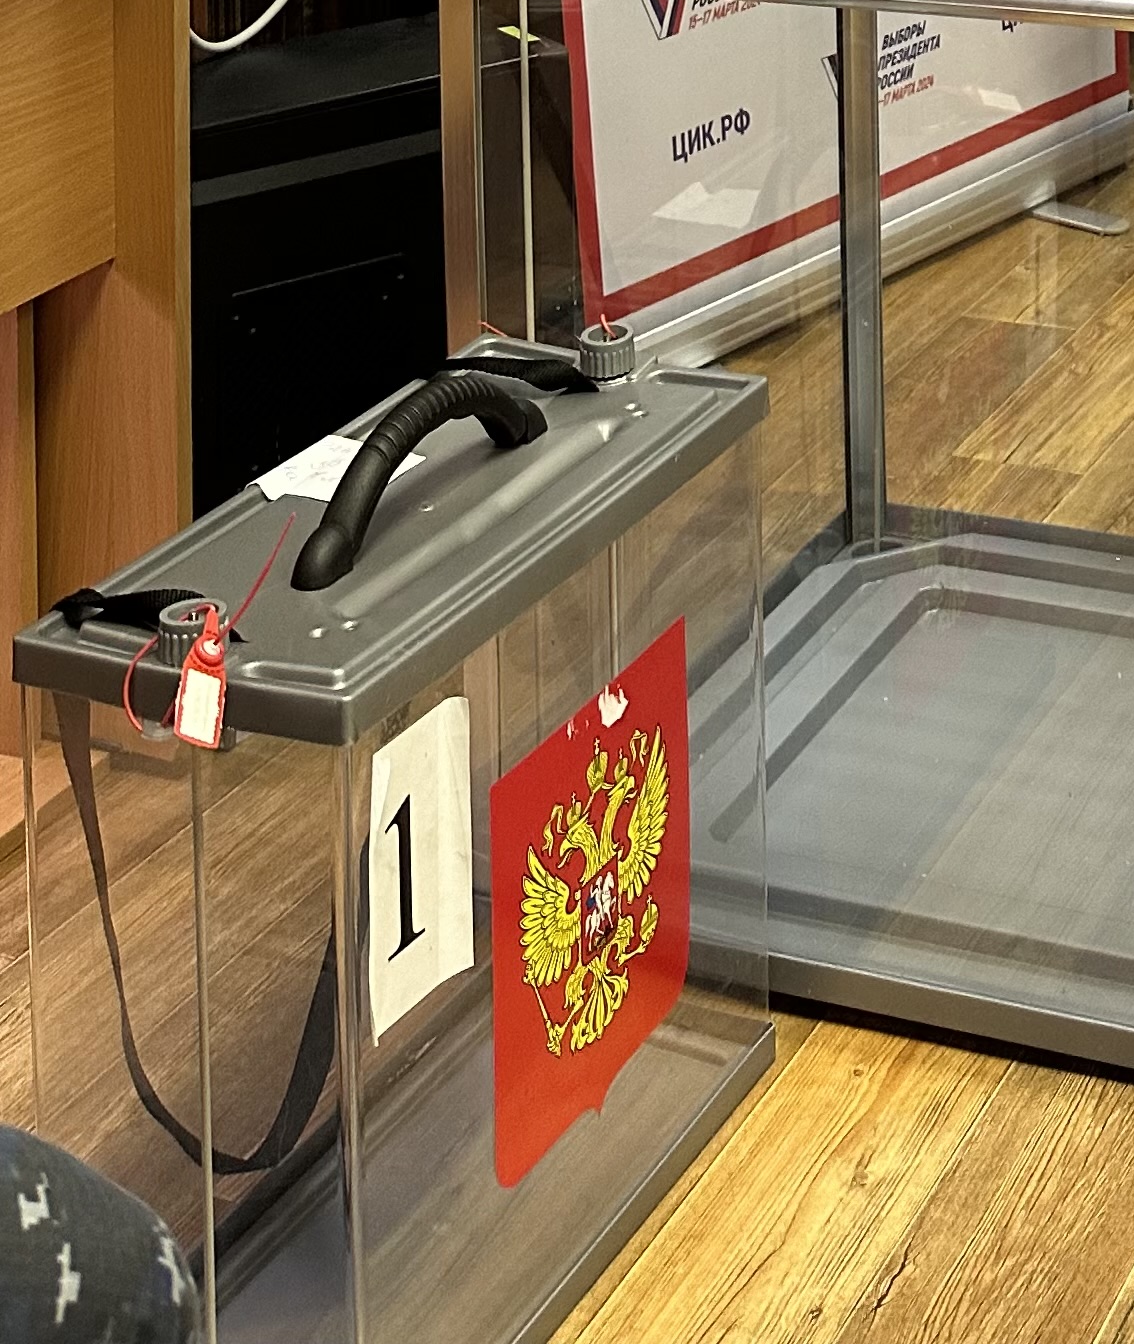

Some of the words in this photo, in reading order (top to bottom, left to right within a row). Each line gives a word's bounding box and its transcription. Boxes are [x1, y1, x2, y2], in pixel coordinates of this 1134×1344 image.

[877, 34, 941, 71] ПРЕЗИДЕНТА
[882, 20, 926, 51] ВЫБОРЫ
[671, 107, 751, 163] ЦИК.РФ
[384, 793, 426, 964] 1
